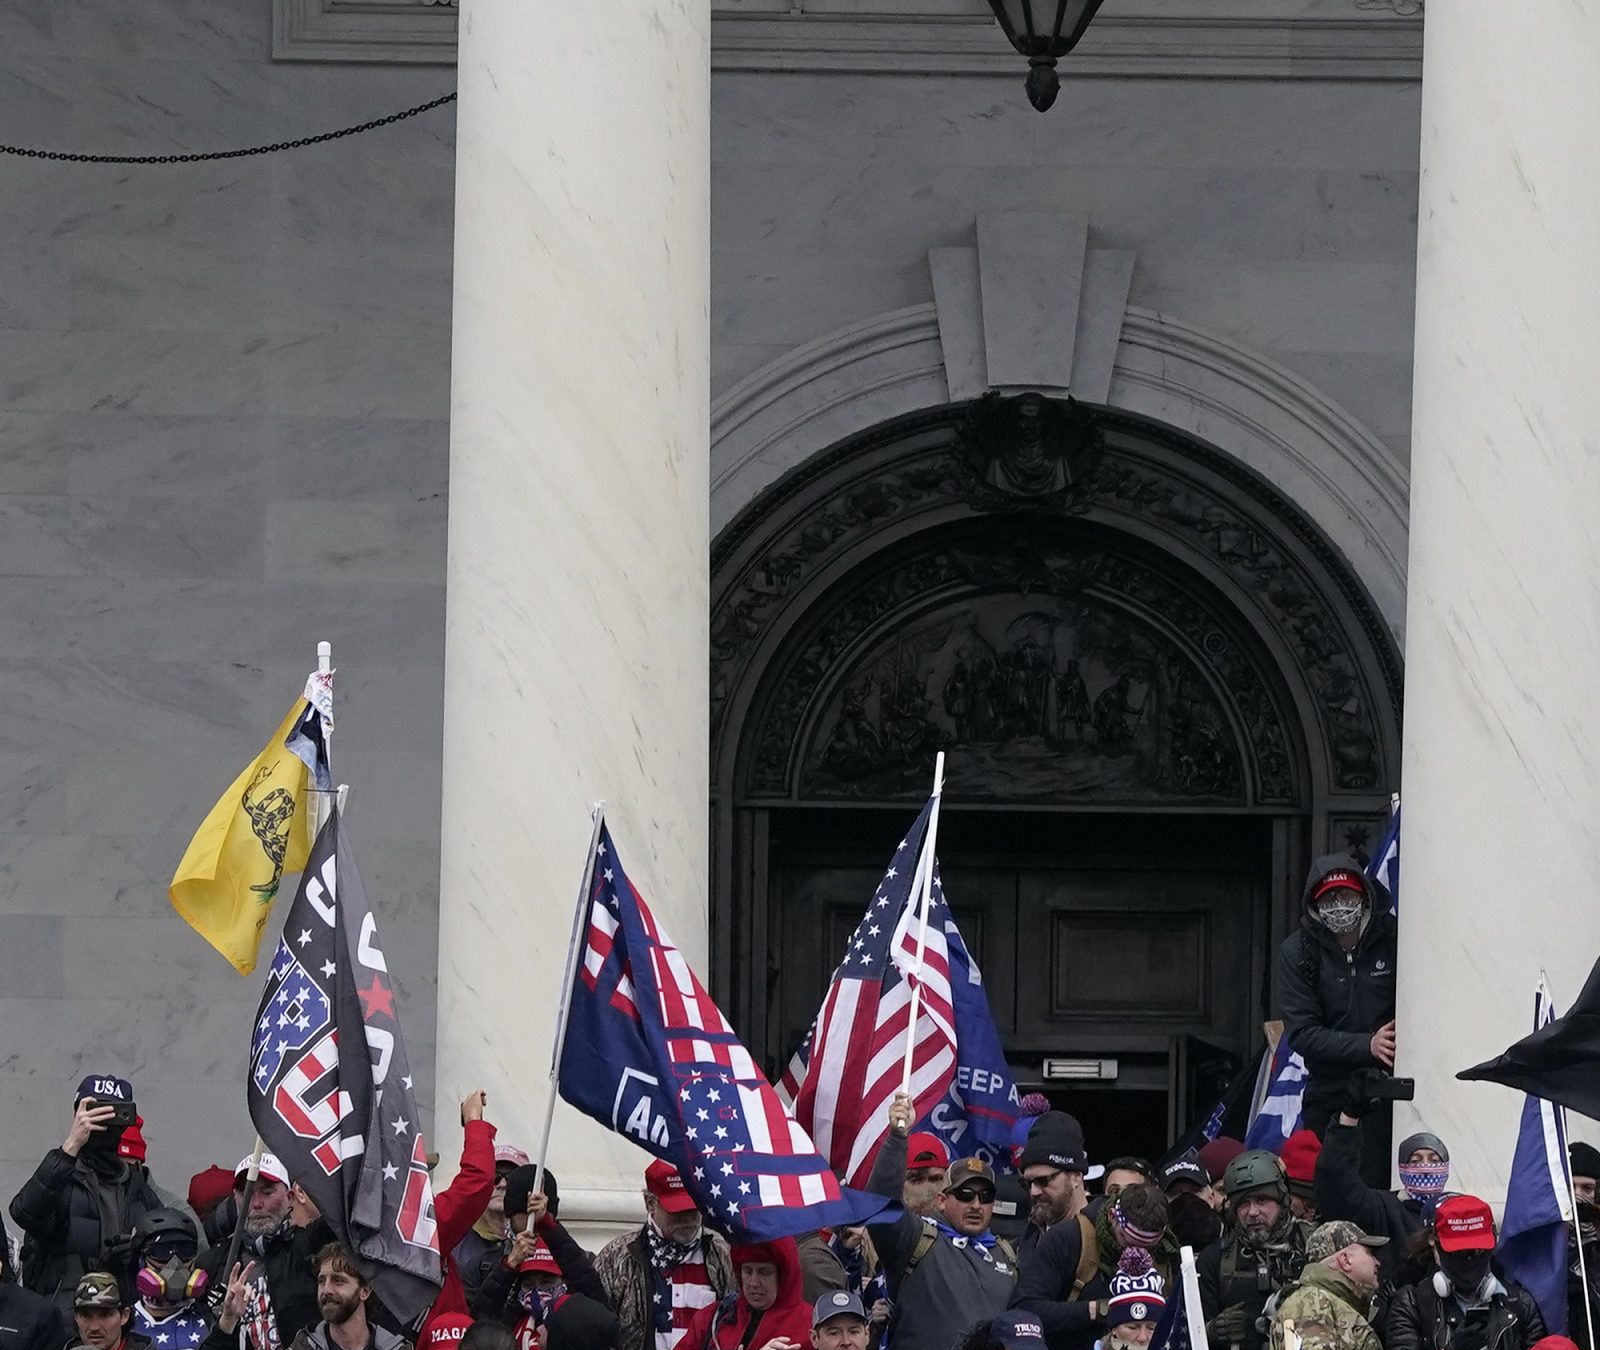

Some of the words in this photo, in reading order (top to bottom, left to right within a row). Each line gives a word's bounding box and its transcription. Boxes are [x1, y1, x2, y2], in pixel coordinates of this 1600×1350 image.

[956, 1066, 1004, 1096] EEP
[94, 1080, 125, 1099] USA
[1134, 1305, 1145, 1316] 45
[1014, 1323, 1041, 1334] TRUMP
